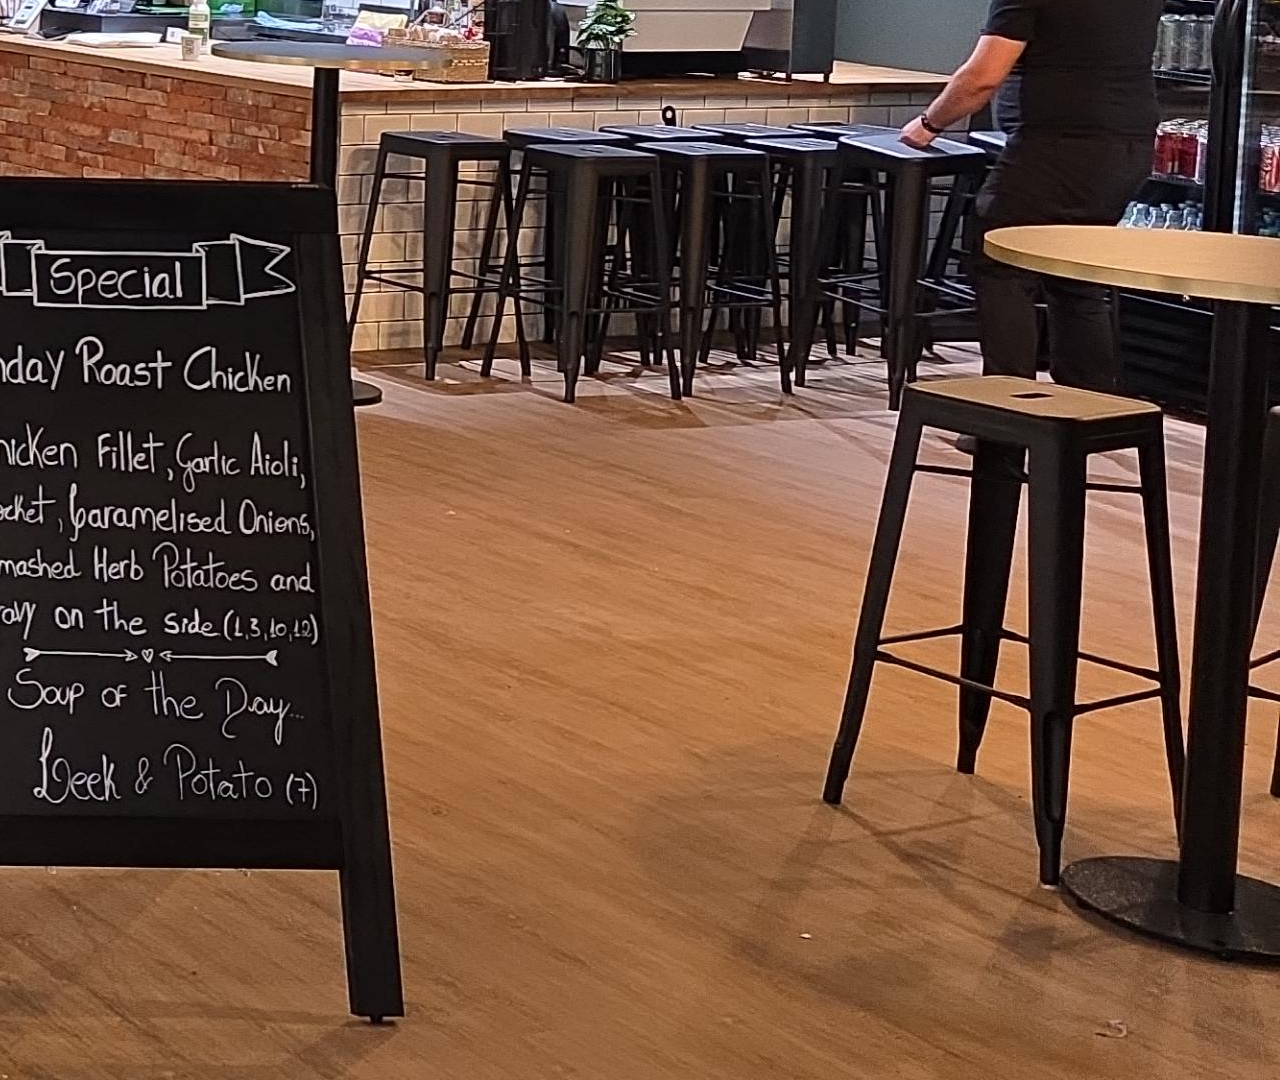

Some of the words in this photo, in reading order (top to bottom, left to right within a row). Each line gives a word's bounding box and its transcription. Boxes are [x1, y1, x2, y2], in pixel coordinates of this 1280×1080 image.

[48, 260, 183, 301] Special
[76, 337, 171, 390] Roast
[184, 346, 291, 394] Chicken
[249, 436, 307, 488] Aioli,
[68, 483, 231, 542] Caramelised
[239, 502, 316, 541] Onions,
[93, 545, 145, 581] Herb
[152, 542, 258, 592] Potatoes
[270, 565, 315, 593] and
[54, 608, 85, 630] on
[93, 601, 147, 635] the
[8, 668, 85, 710] Soup
[102, 685, 129, 708] of
[144, 671, 204, 720] the
[32, 728, 123, 803] Leek
[135, 754, 153, 788] &
[163, 744, 273, 801] Potato
[286, 771, 319, 810] (7)
